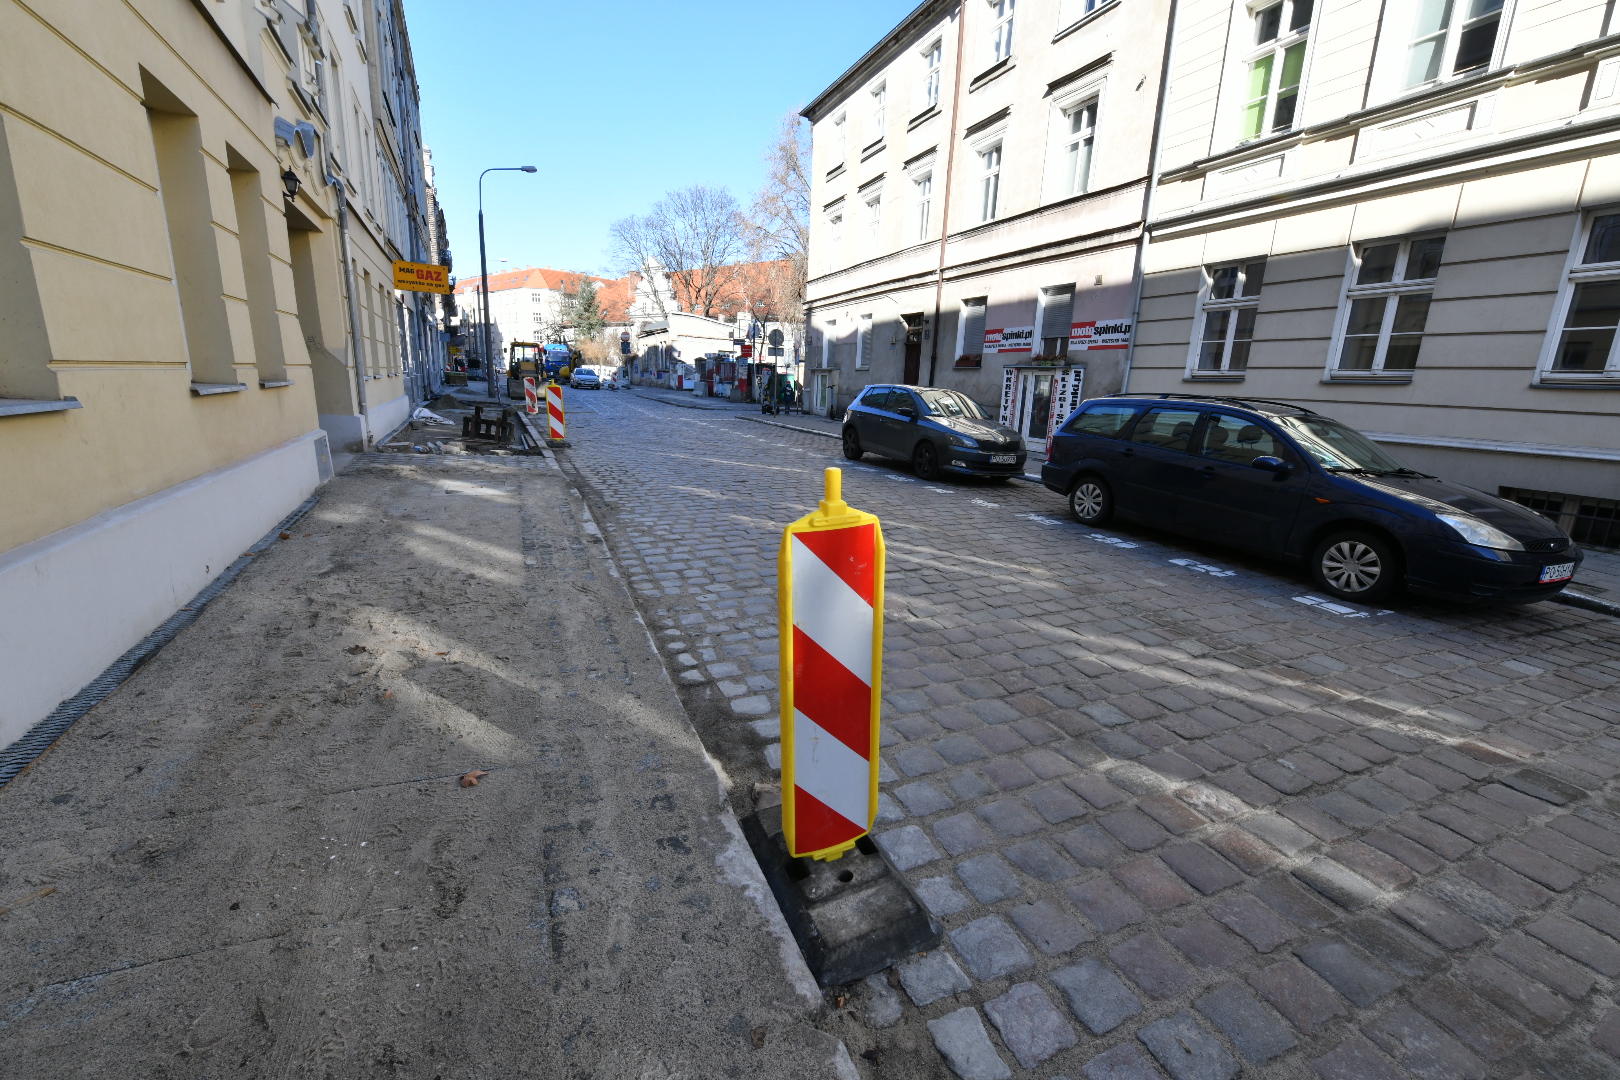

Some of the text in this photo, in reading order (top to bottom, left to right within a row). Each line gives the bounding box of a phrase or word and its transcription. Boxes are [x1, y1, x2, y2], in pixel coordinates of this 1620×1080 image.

[416, 269, 443, 281] GAZ
[1071, 322, 1131, 337] motospinki.p
[985, 330, 1033, 342] motospinki.pl
